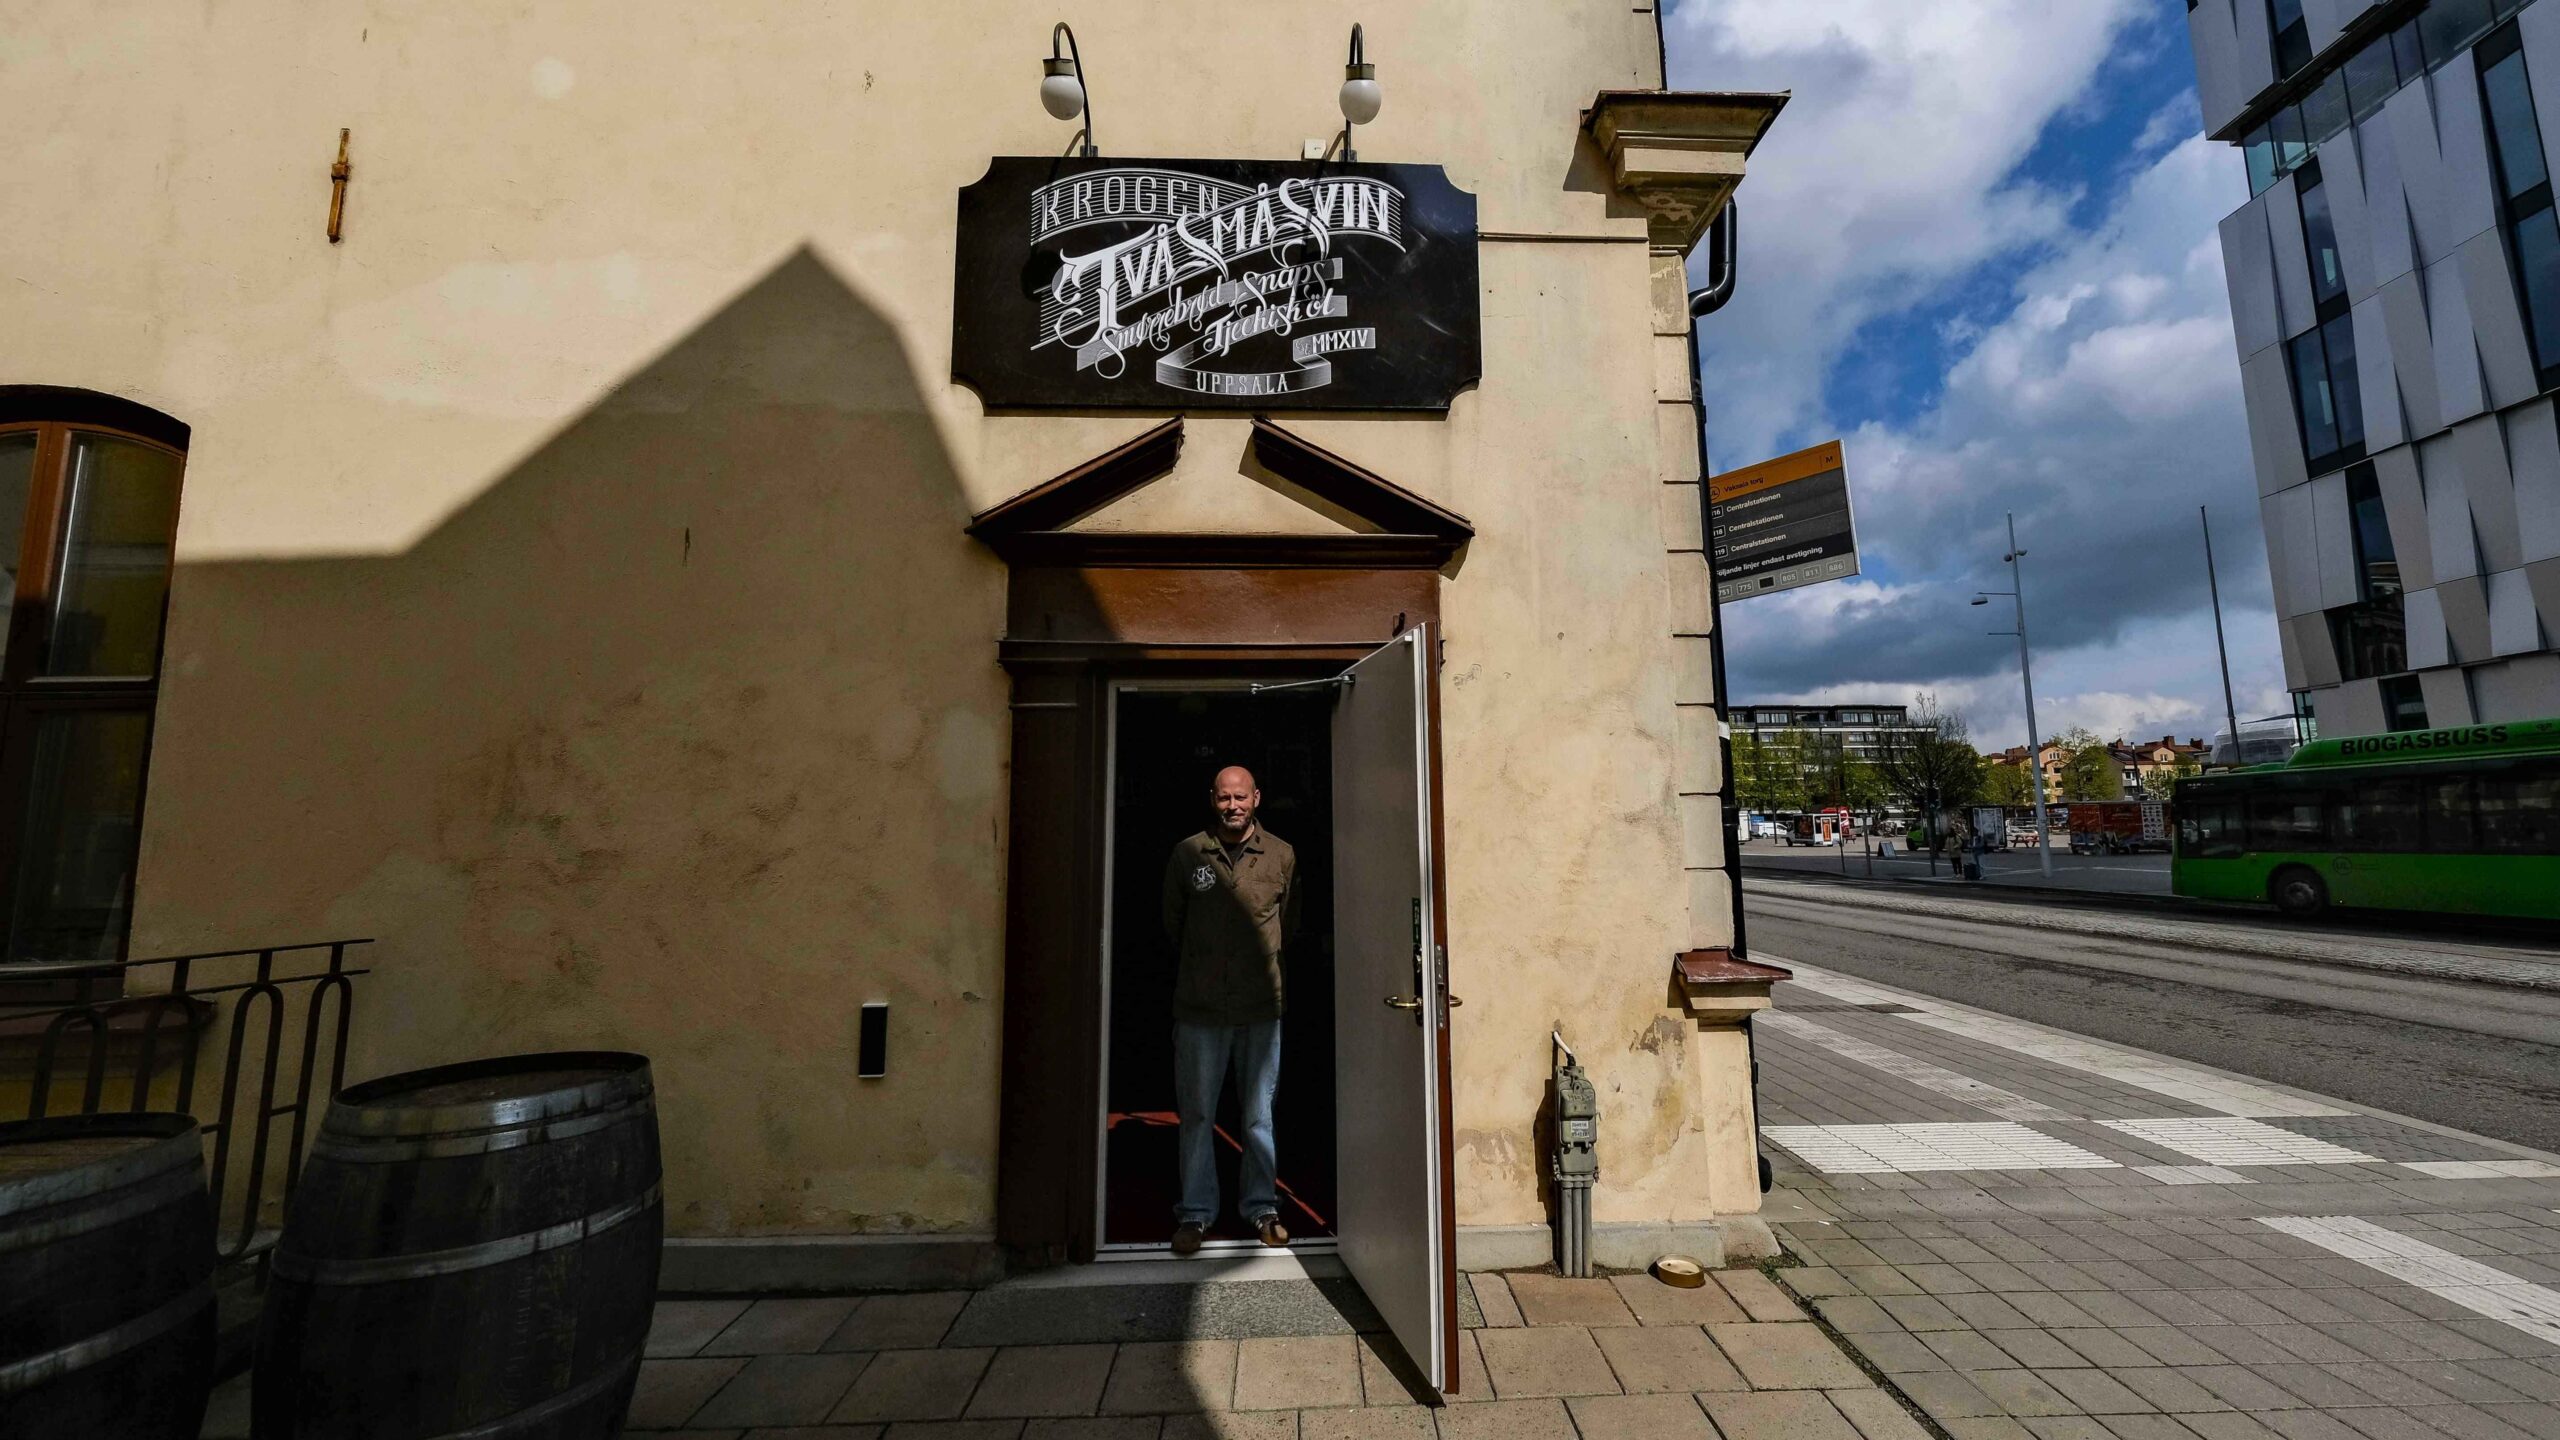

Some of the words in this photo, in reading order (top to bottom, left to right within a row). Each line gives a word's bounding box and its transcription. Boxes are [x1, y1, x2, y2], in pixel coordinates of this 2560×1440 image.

[1041, 176, 1219, 233] KROGEN
[1052, 224, 1176, 349] TVÅ
[1170, 182, 1277, 284] SMÅ
[1272, 177, 1391, 266] SVIN
[1312, 329, 1369, 354] MMXIV
[1196, 372, 1289, 394] UPPSALA
[1726, 493, 1781, 512] Centralstationen
[1728, 513, 1784, 532] Centralstationen
[1714, 547, 1726, 557] 119
[1731, 534, 1787, 552] Centralstationen
[1743, 561, 1760, 571] linjer
[1761, 554, 1785, 566] endast
[1786, 546, 1823, 561] avstigning
[1738, 583, 1752, 593] 775
[2341, 725, 2508, 756] BIOGASBUSS
